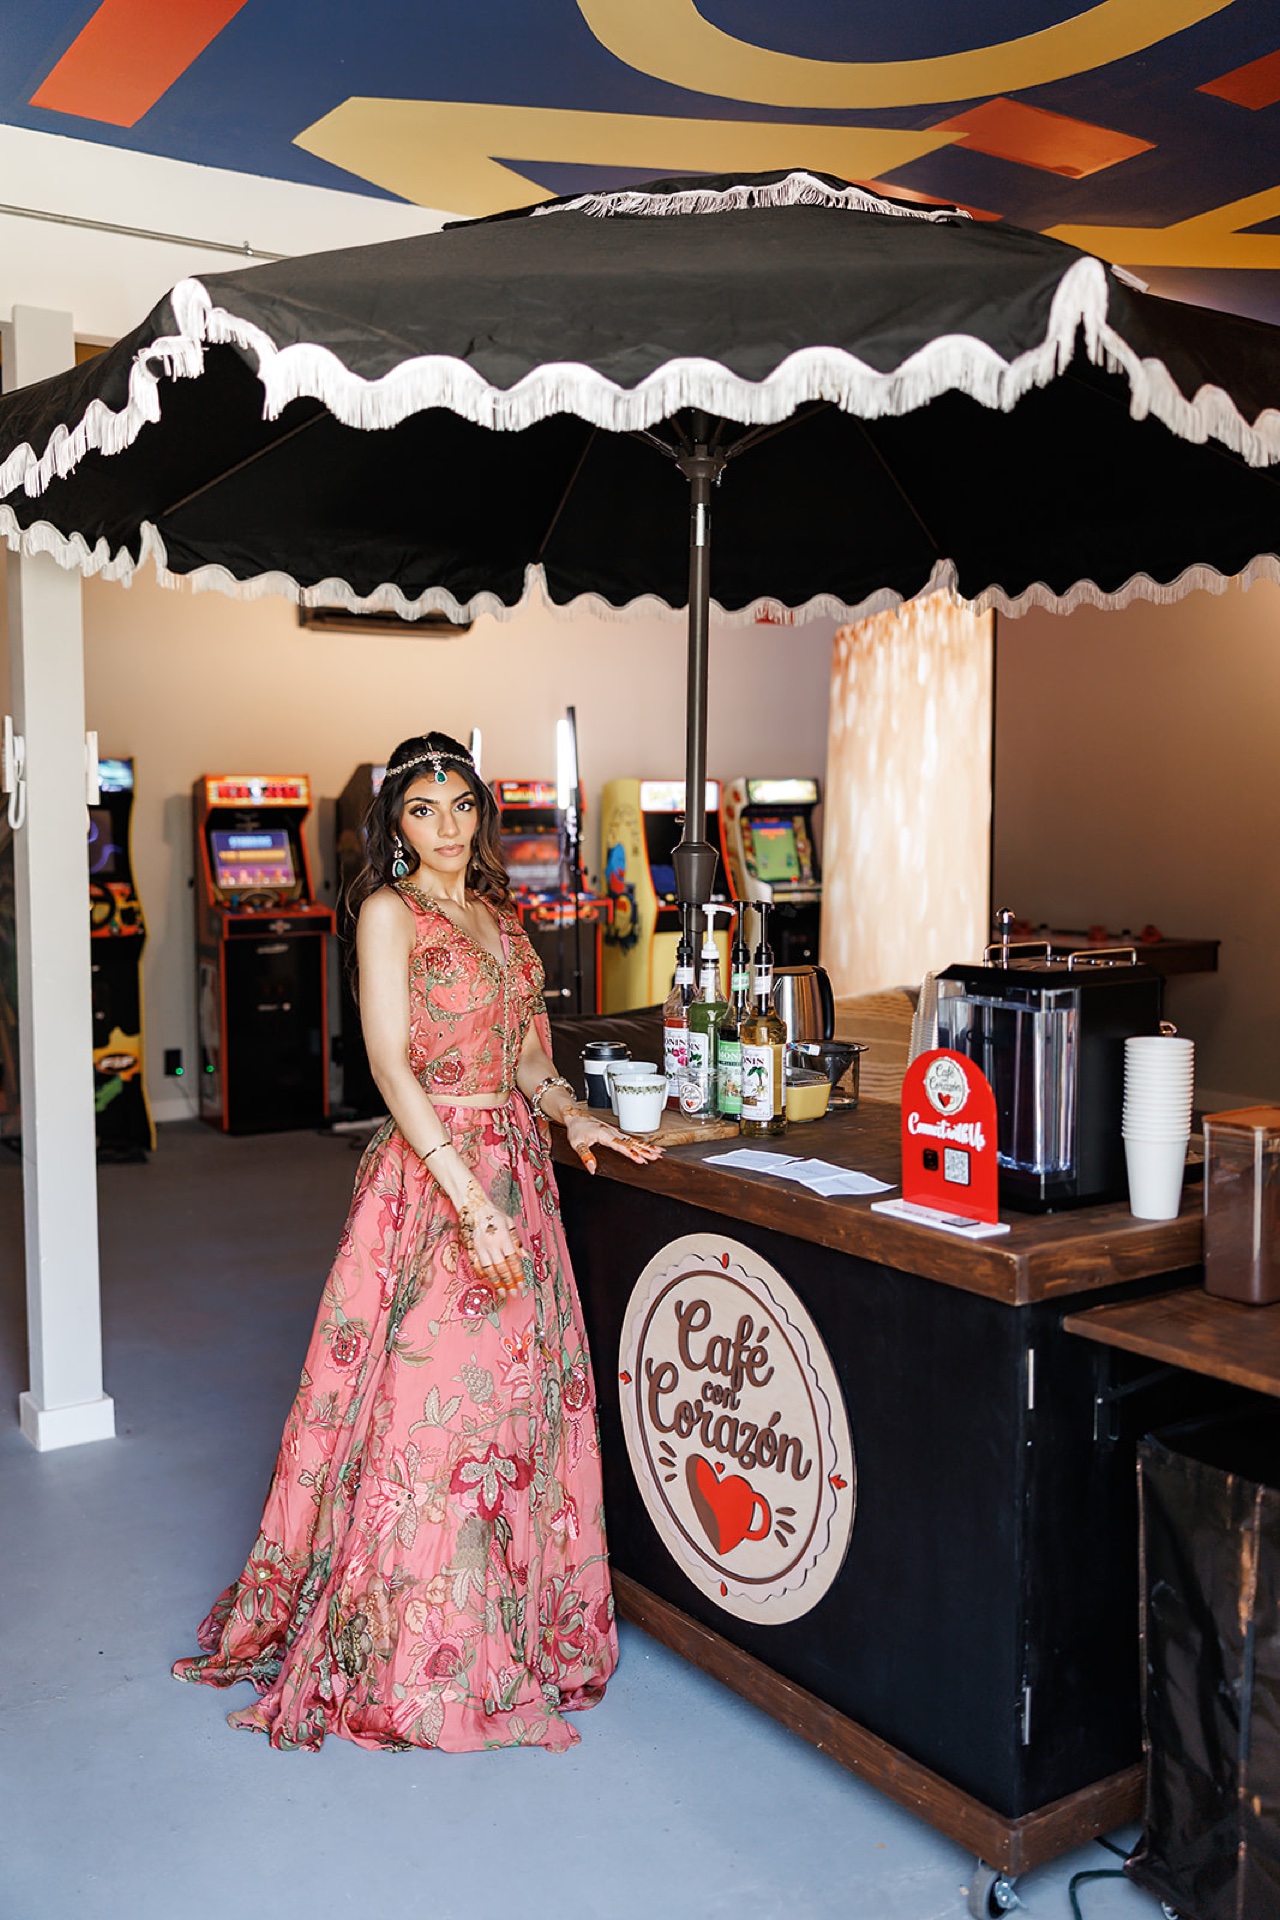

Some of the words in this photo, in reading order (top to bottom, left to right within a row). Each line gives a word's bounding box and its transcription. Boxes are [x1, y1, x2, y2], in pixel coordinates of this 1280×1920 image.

[674, 1298, 775, 1393] Café
[644, 1355, 812, 1482] Corazón
[700, 1379, 741, 1412] con
